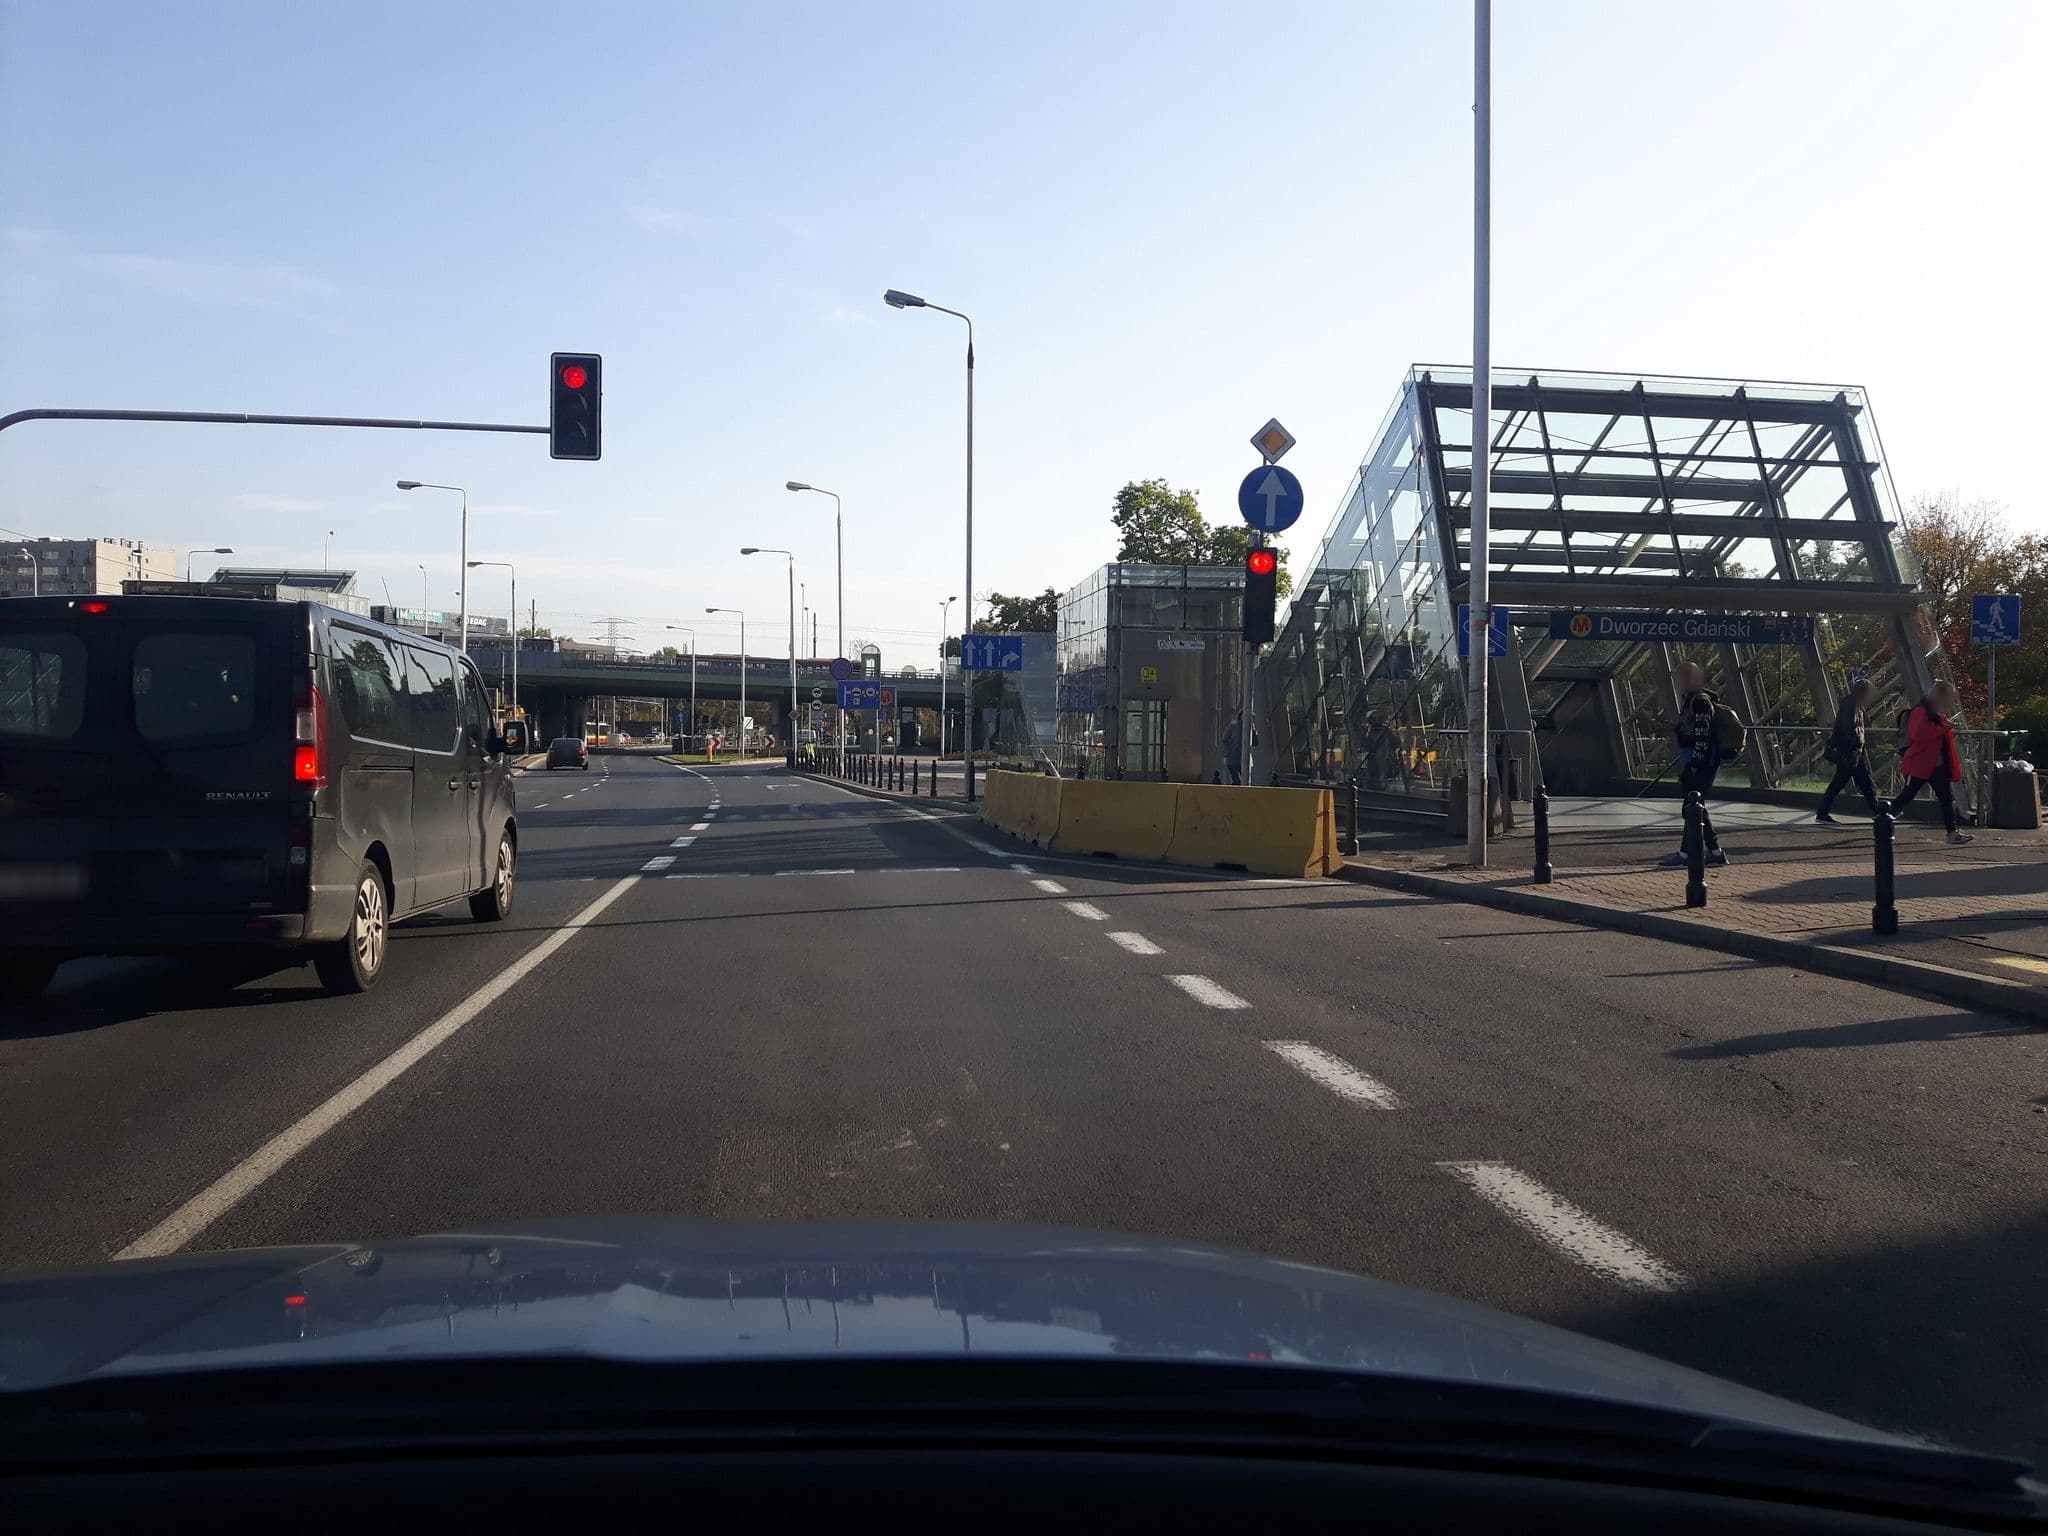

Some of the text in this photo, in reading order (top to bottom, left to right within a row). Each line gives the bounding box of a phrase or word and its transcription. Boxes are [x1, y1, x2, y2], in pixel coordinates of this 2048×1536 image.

[1600, 616, 1678, 636] Dworzec
[1684, 618, 1751, 638] Gdański
[206, 792, 271, 801] RENAULT
